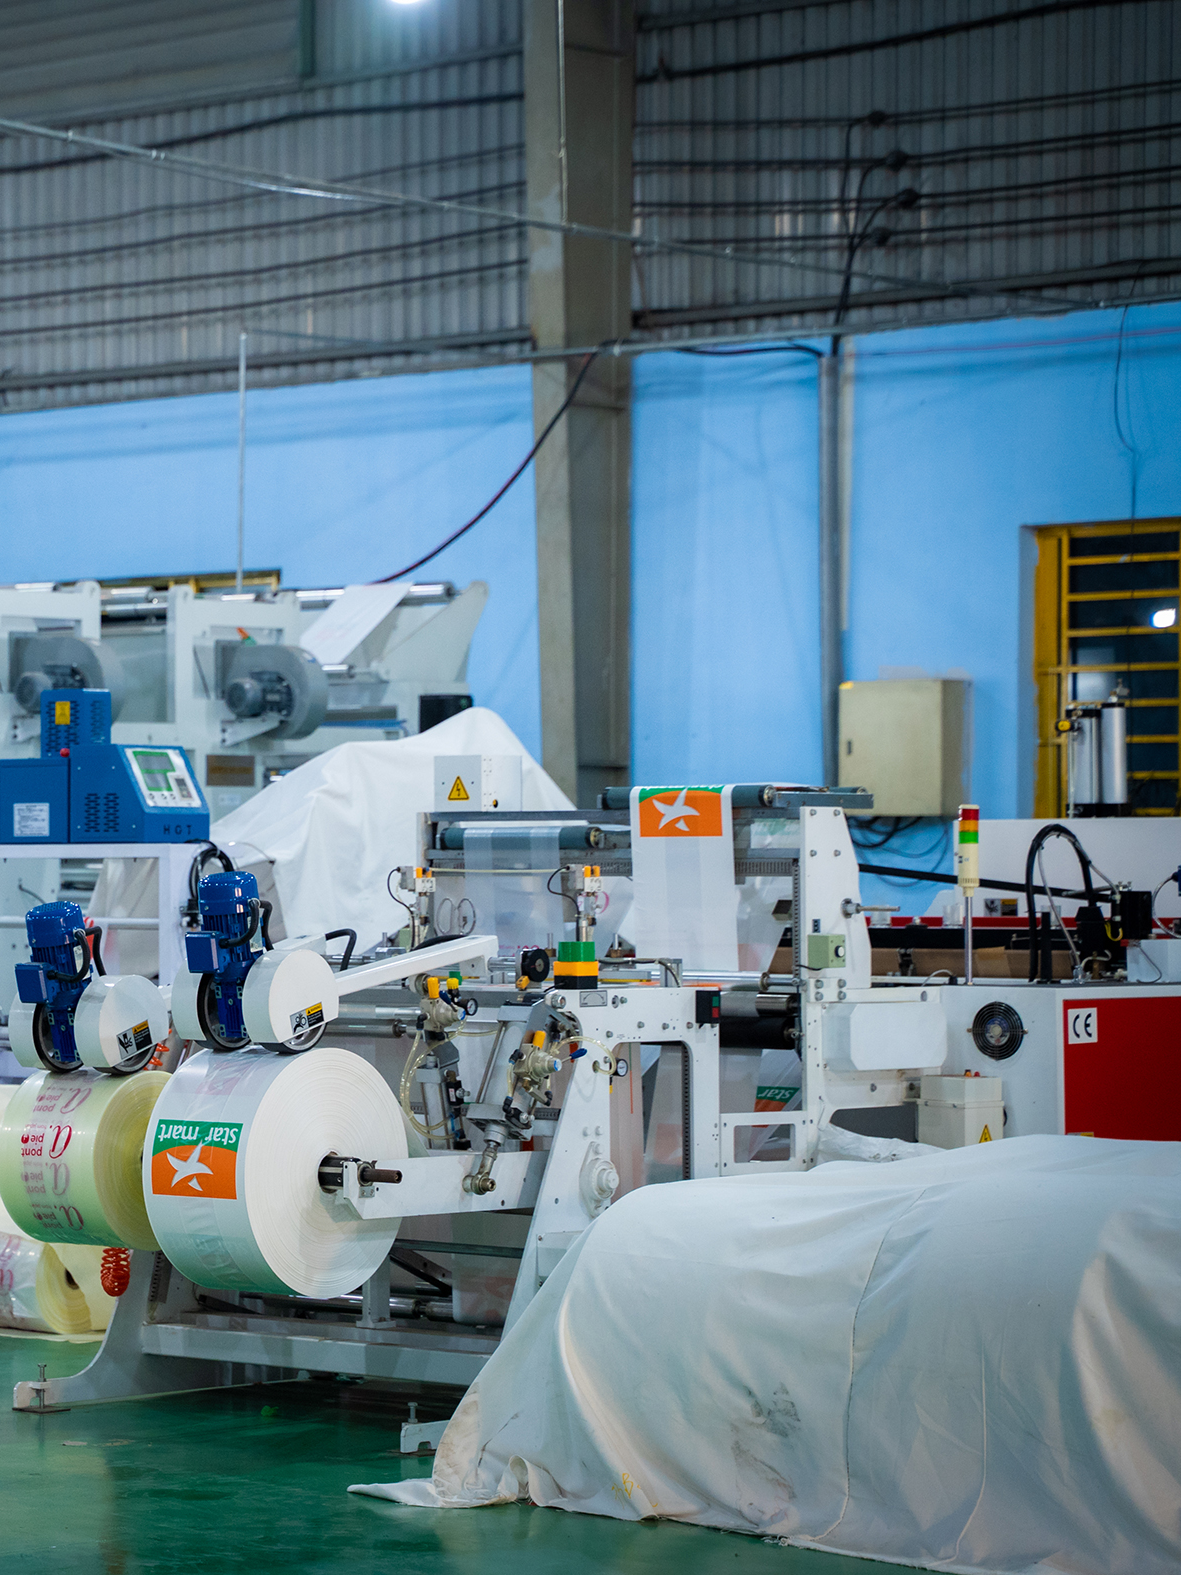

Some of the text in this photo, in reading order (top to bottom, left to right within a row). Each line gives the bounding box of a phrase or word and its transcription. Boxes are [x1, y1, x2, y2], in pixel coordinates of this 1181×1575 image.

[1072, 1012, 1092, 1039] CE
[758, 1089, 794, 1099] star
[30, 1132, 44, 1145] pie
[158, 1124, 238, 1146] star mart
[21, 1146, 42, 1157] pont
